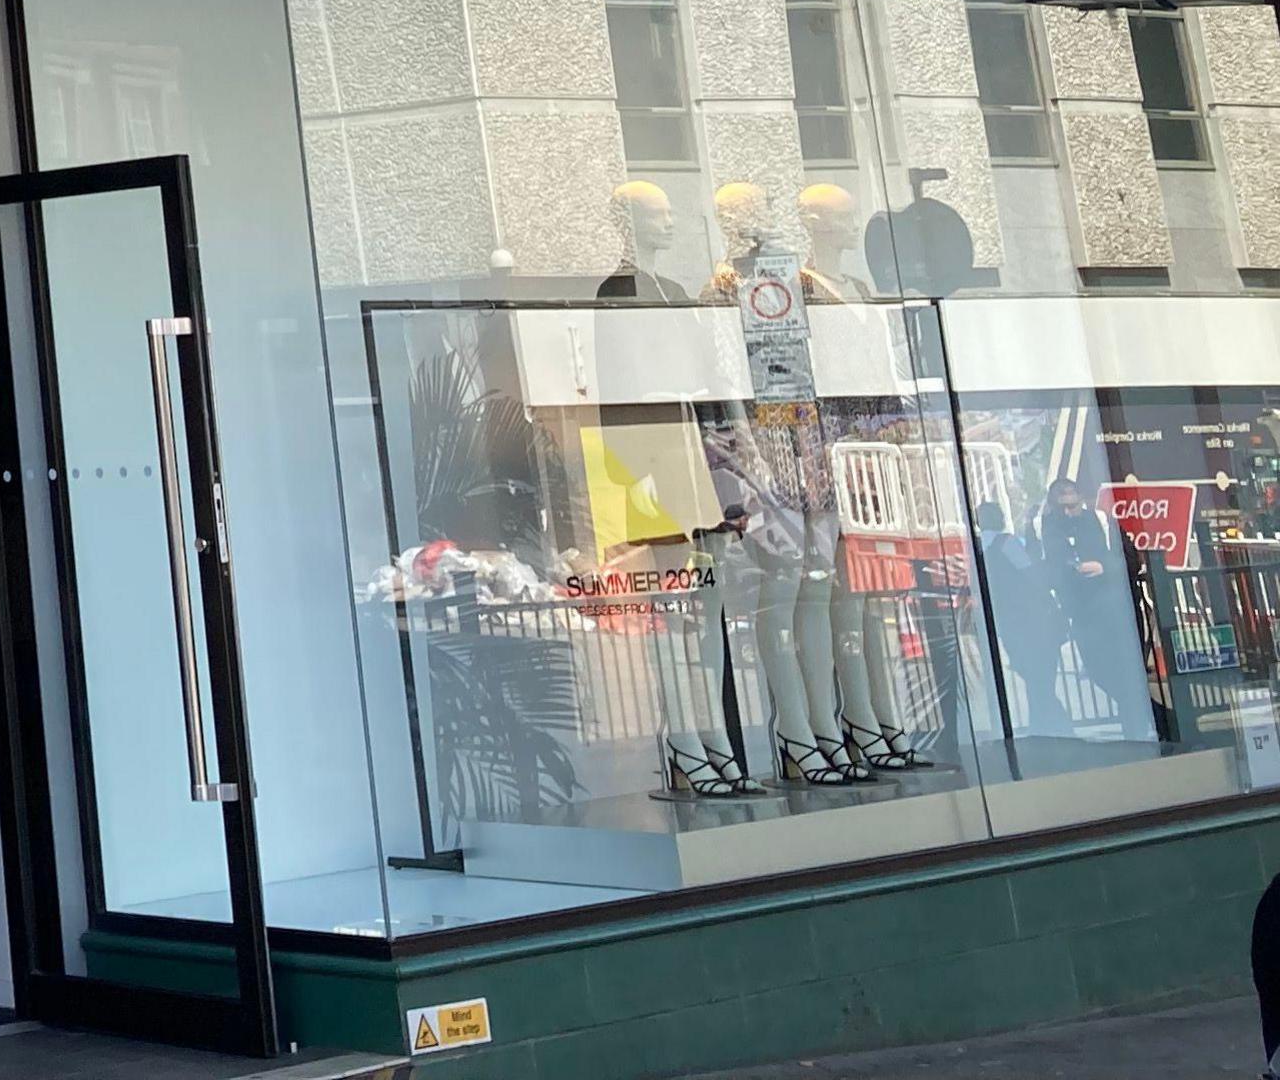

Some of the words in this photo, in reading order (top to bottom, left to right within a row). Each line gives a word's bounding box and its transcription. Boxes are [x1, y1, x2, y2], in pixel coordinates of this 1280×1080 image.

[566, 571, 662, 598] SUMMER
[665, 567, 716, 591] 2024
[451, 1009, 472, 1022] Mind
[446, 1026, 460, 1038] the
[462, 1023, 481, 1036] step
